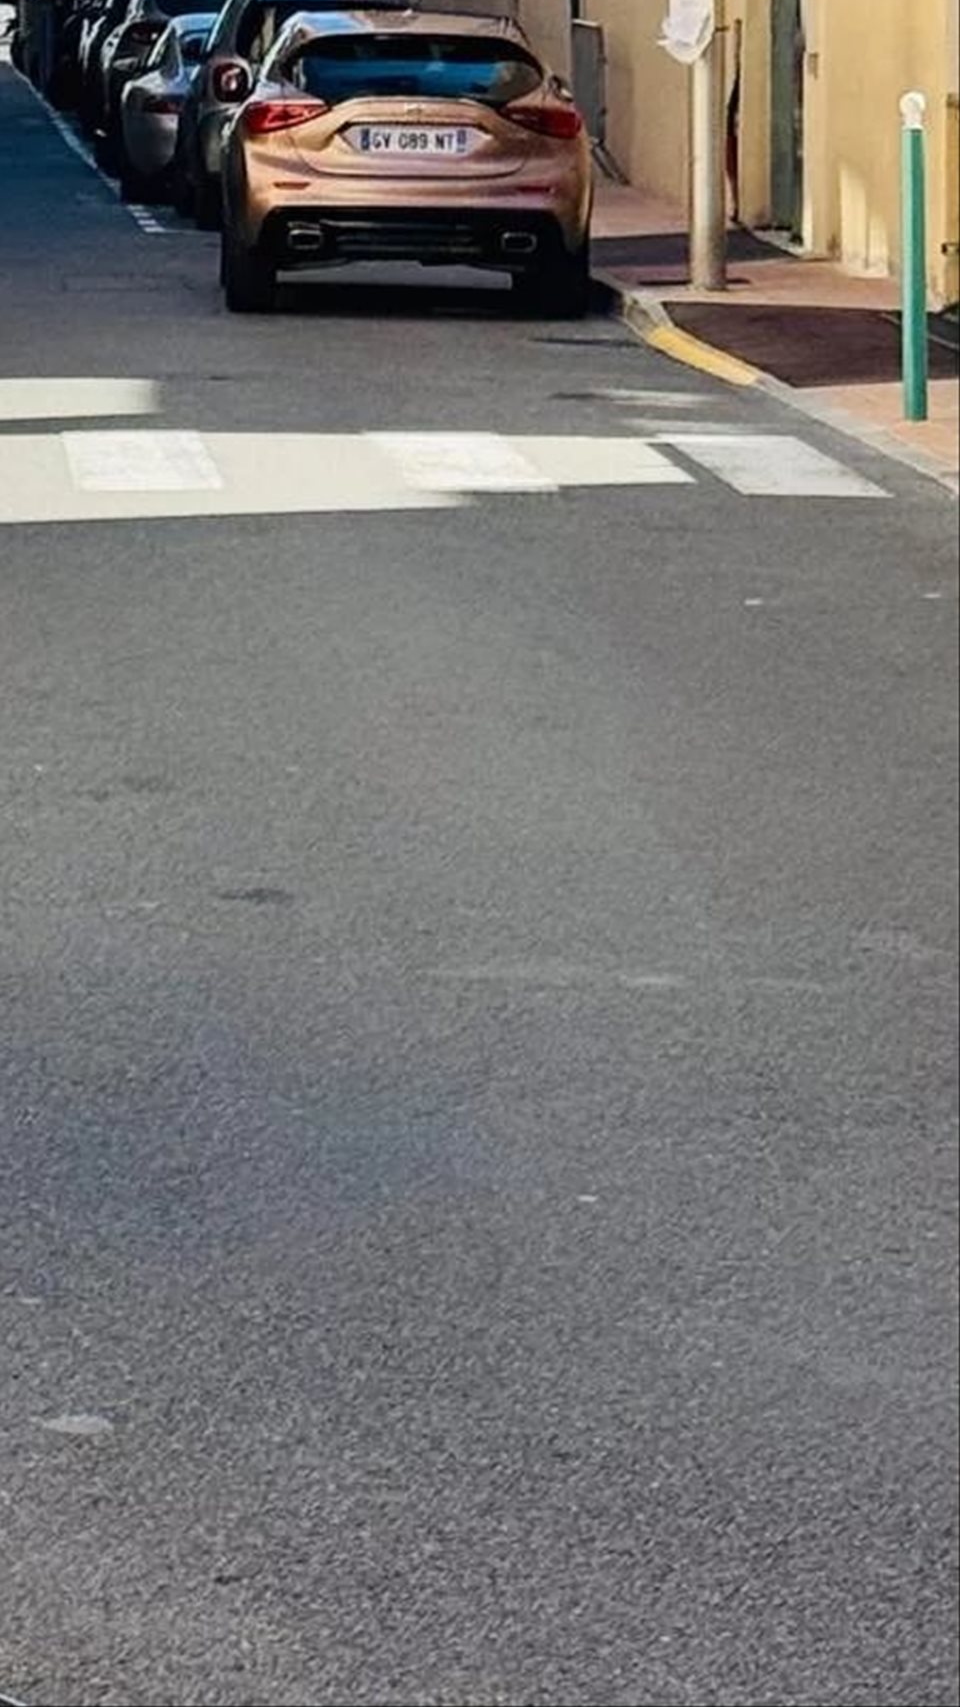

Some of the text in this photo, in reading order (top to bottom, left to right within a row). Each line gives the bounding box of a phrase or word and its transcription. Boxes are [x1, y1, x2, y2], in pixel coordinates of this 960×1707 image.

[373, 132, 454, 150] GV 089 NT
